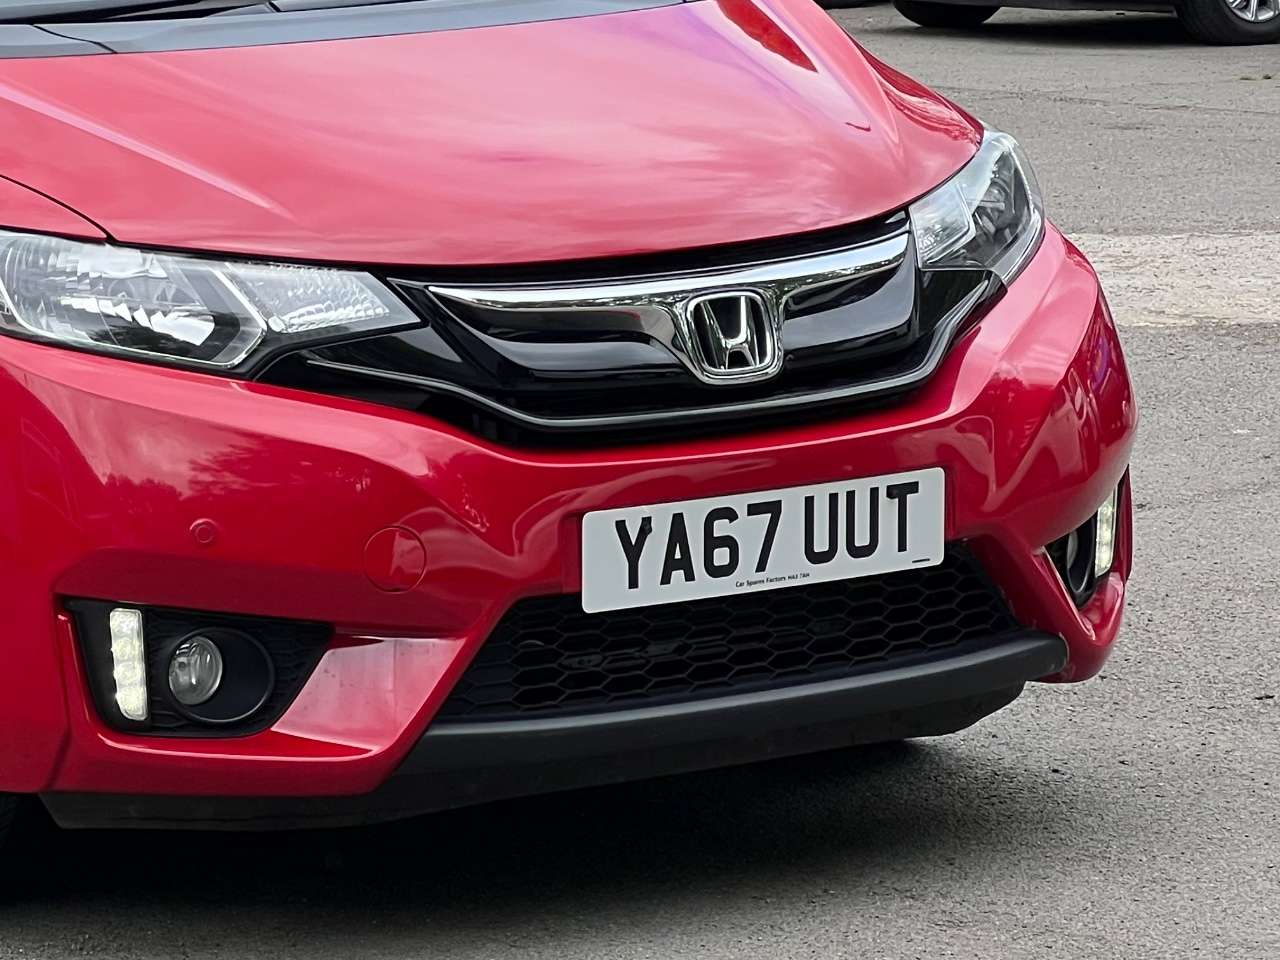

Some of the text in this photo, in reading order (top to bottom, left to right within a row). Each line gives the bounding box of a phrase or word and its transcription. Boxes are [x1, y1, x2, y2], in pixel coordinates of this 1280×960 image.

[614, 480, 919, 589] YA67 UUT
[735, 580, 745, 588] Car
